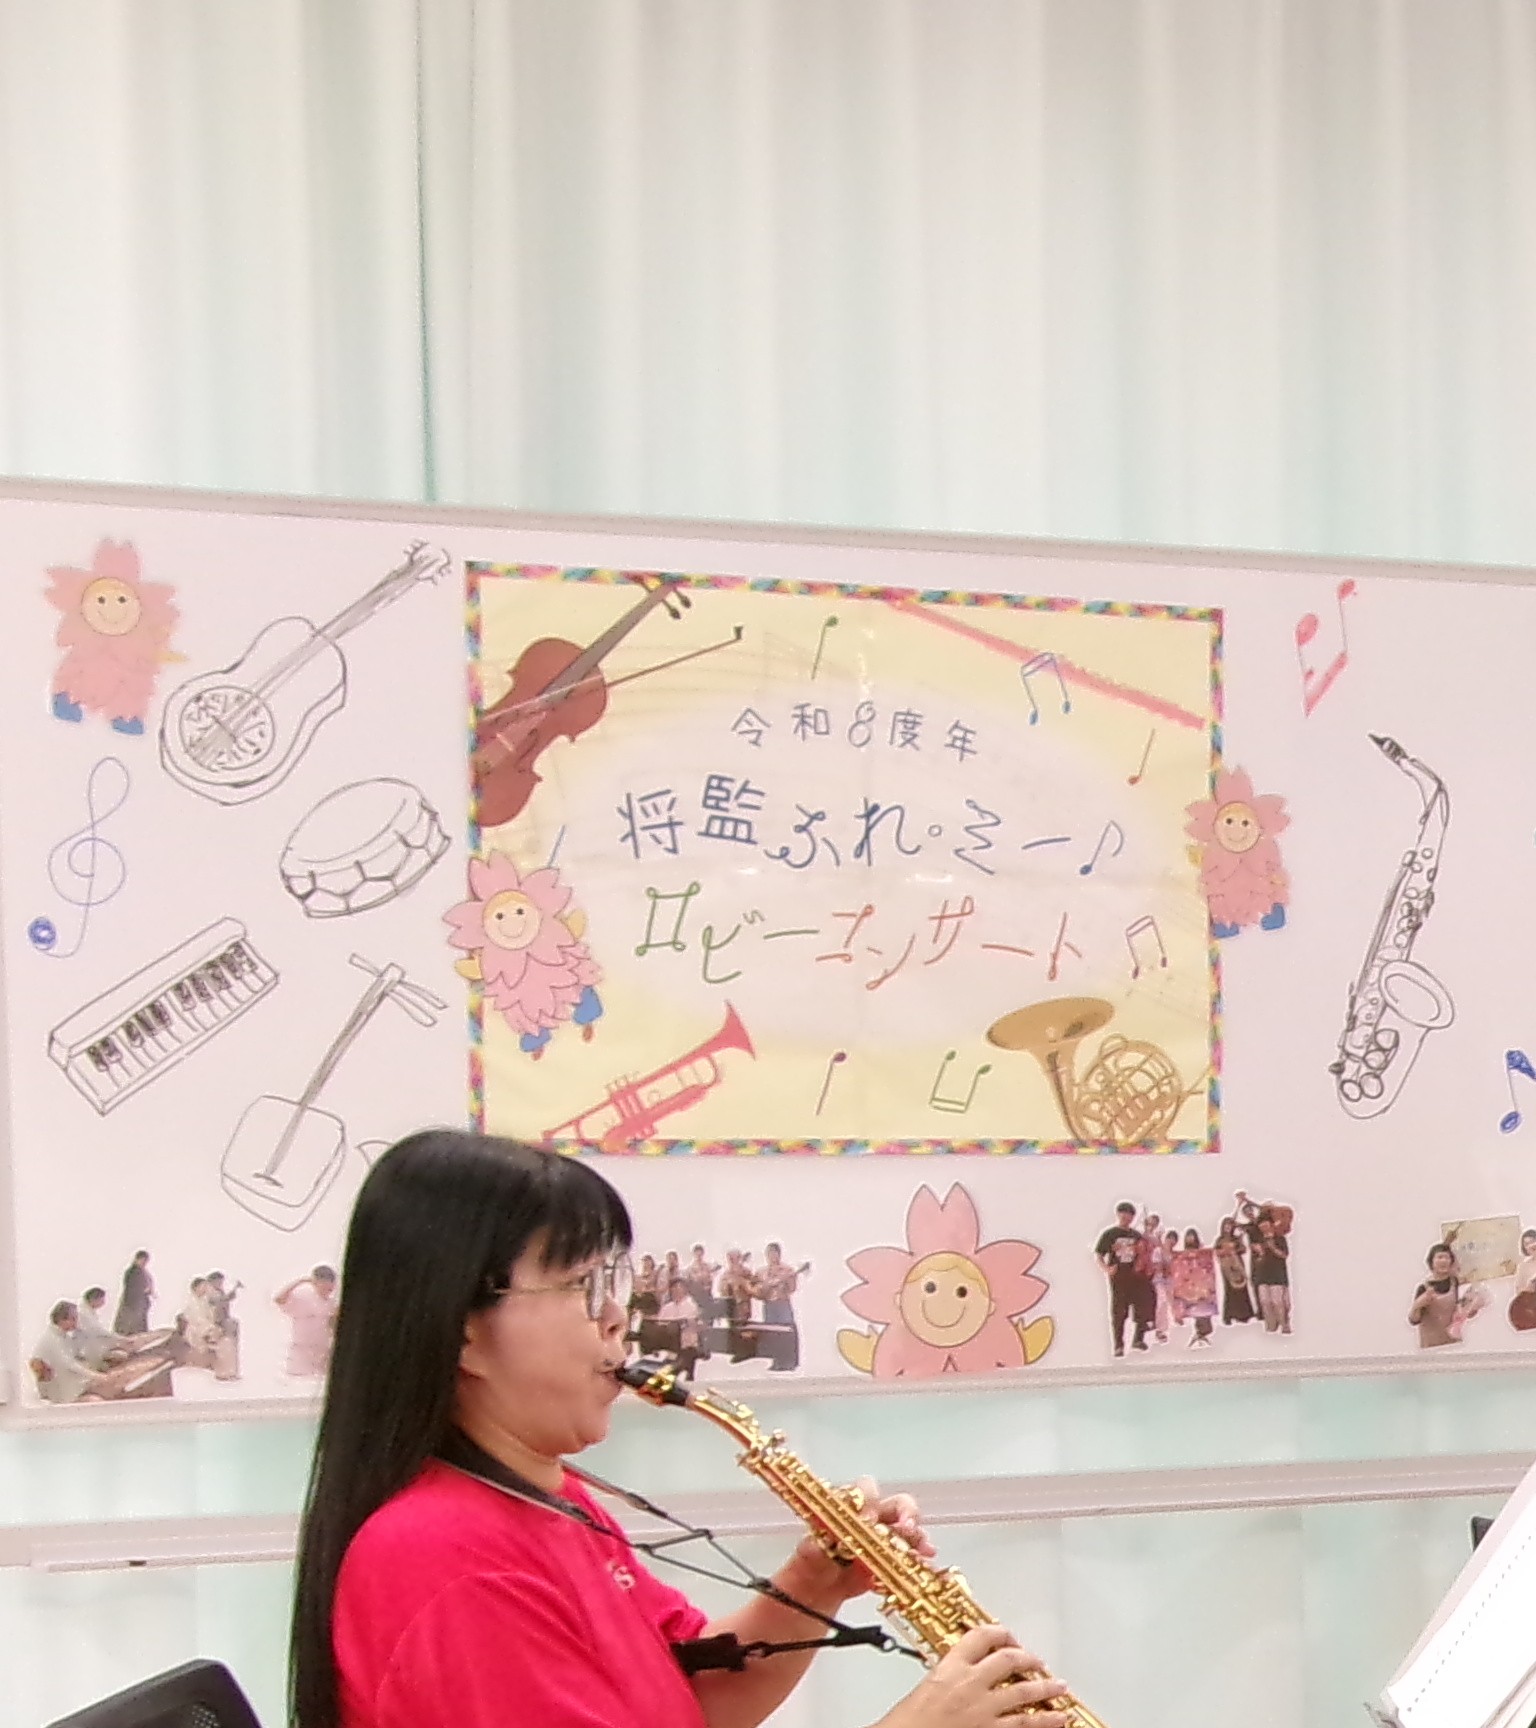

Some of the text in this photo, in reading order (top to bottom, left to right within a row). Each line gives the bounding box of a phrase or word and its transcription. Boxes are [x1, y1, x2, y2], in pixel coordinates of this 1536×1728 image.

[730, 700, 981, 760] 令和8度年
[635, 881, 1083, 992] ロビーコンサート
